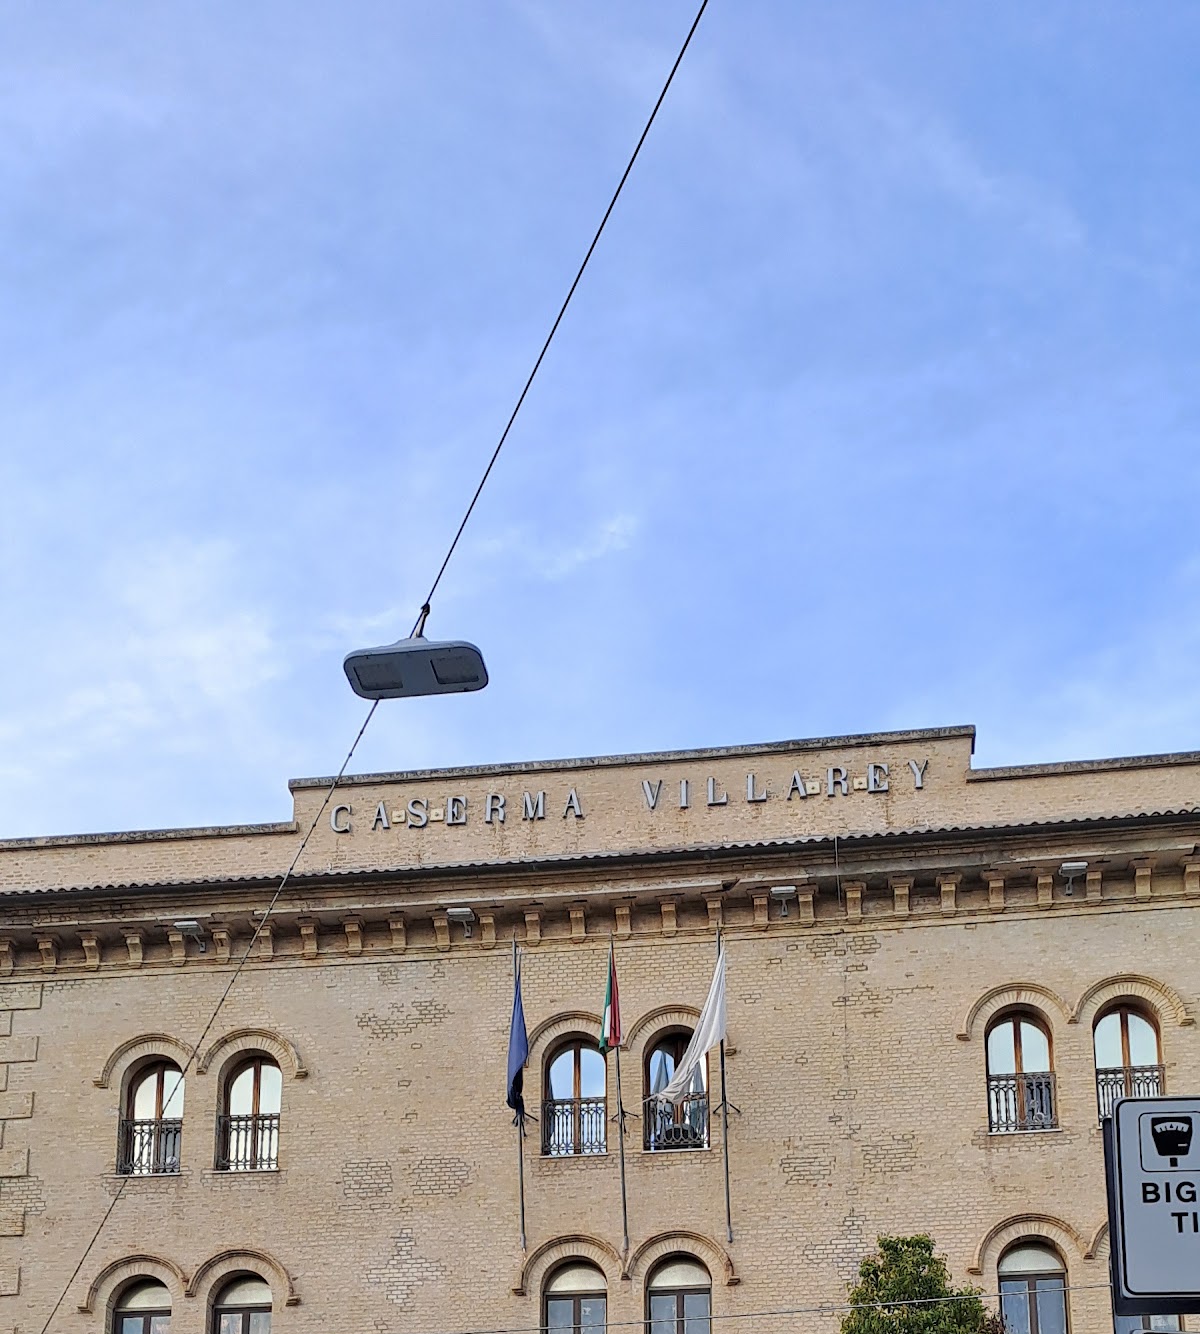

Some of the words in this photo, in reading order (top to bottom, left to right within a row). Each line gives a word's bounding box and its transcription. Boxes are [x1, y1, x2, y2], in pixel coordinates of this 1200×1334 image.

[330, 787, 584, 833] CASERMA
[642, 758, 930, 810] VILLAREY
[1142, 1181, 1197, 1203] BIG
[1171, 1212, 1199, 1233] TI
